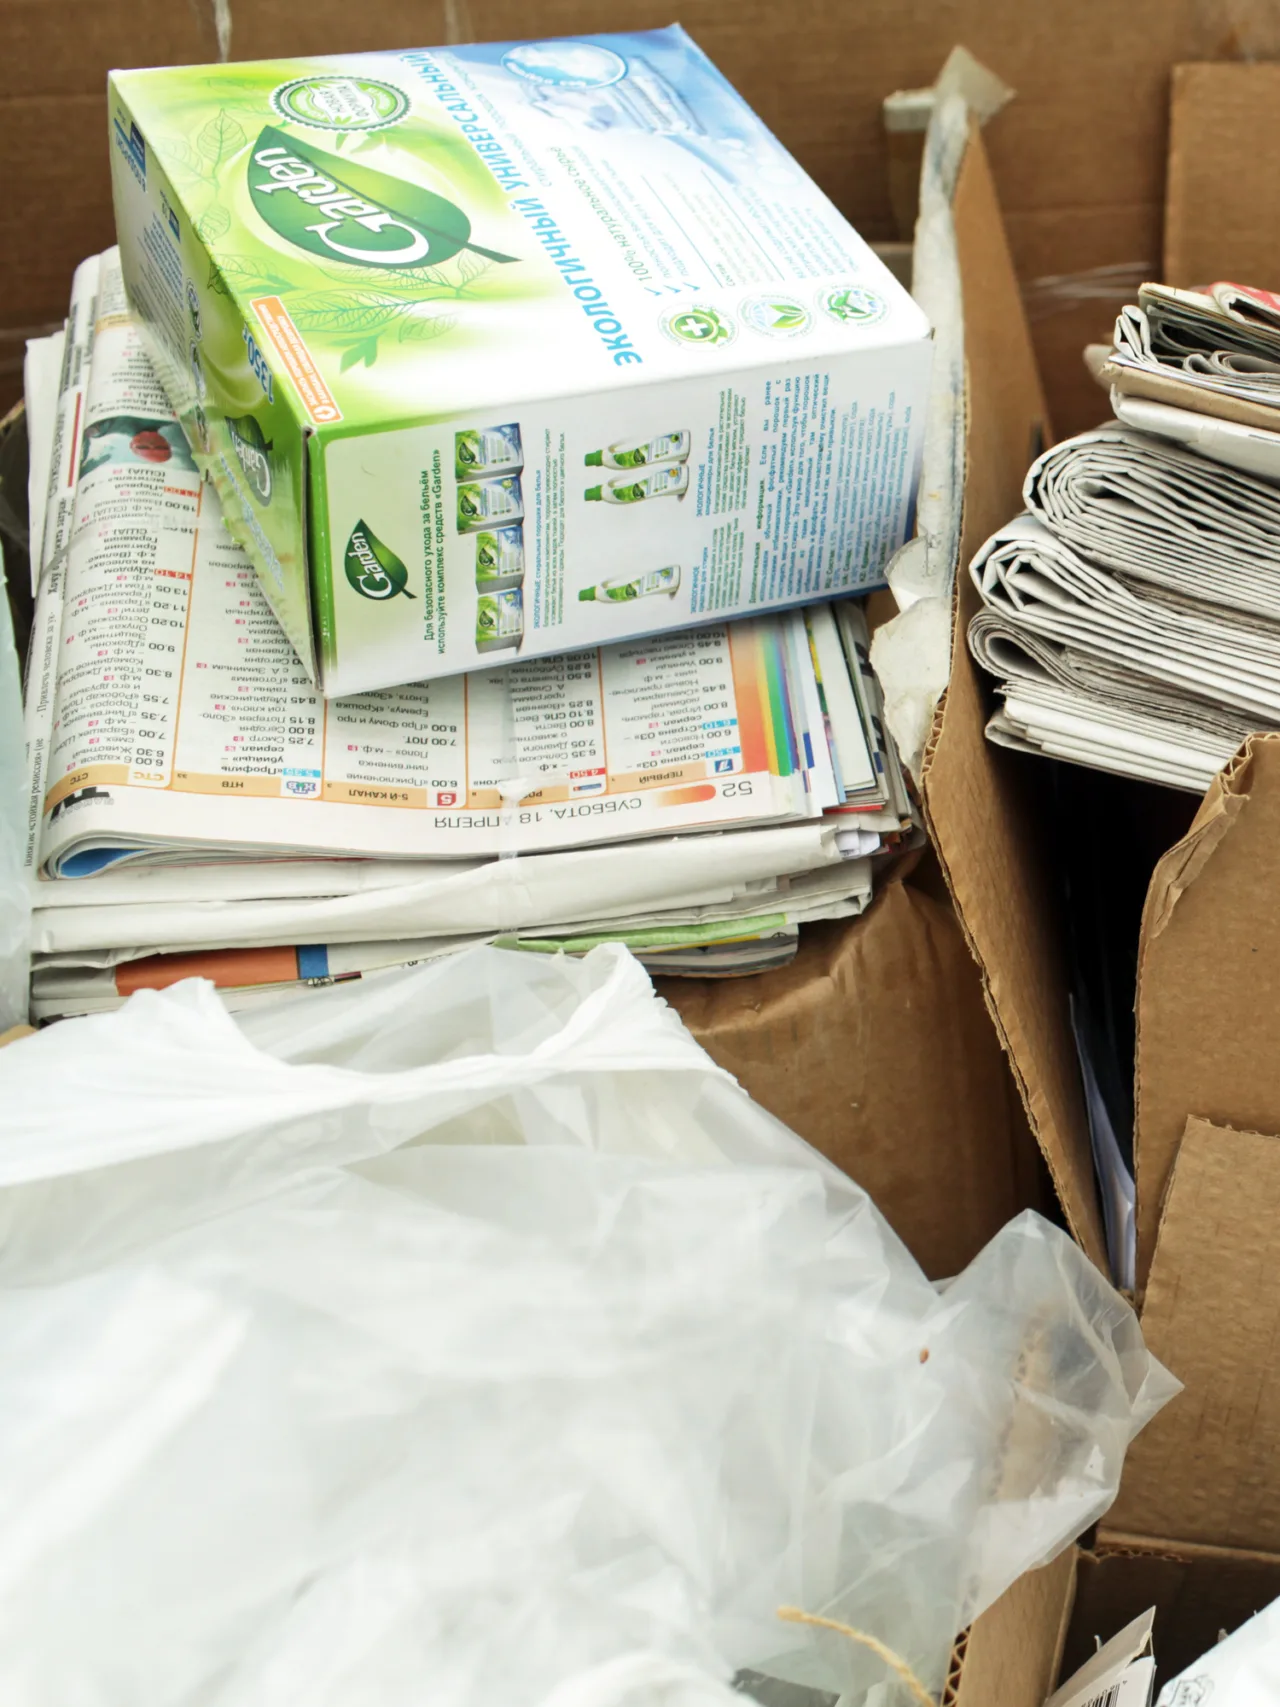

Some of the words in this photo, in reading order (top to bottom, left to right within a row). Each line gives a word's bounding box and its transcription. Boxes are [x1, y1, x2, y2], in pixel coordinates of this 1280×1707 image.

[318, 89, 347, 113] НОВАЯ
[333, 83, 372, 118] ФОРМУЛА
[396, 50, 532, 192] УНИВЕРСАЛЬНЫЙ
[546, 145, 584, 177] сырьё
[253, 146, 430, 265] Garden
[570, 177, 635, 247] натуральное
[617, 249, 656, 282] 100%
[504, 196, 652, 366] ЭКОЛОГИЧНЫЙ
[763, 380, 772, 405] ранее
[790, 376, 801, 413] функцию
[801, 375, 810, 410] порошок
[810, 373, 820, 419] оптический
[771, 395, 781, 433] порошок
[781, 396, 790, 428] первый
[762, 418, 769, 431] вы
[798, 412, 807, 437] чтобы
[759, 444, 767, 465] Если
[798, 439, 806, 458] того,
[430, 448, 442, 499] «Garden»
[766, 443, 777, 492] фосфатный
[796, 460, 804, 475] для
[418, 469, 430, 511] бельём
[695, 462, 705, 517] ЭКОЛОГИЧНЫЕ
[422, 512, 430, 524] за
[434, 501, 444, 544] средств
[422, 526, 433, 557] ухода
[104, 566, 154, 574] «Дурдом
[347, 531, 392, 599] Garden
[434, 545, 445, 593] комплекс
[48, 572, 62, 594] Хочу
[156, 585, 187, 595] 13.05
[422, 558, 434, 621] безопасного
[153, 601, 186, 612] 11.20
[152, 618, 184, 628] 10.20
[435, 595, 447, 654] используйте
[84, 632, 146, 643] Защитники
[424, 622, 435, 641] Для
[41, 635, 54, 671] человека
[149, 643, 175, 652] 9.00
[242, 657, 289, 665] Сегодня.
[114, 666, 142, 674] «Том
[146, 668, 172, 678] 8.30
[37, 673, 52, 712] Привлечь
[86, 692, 139, 702] «Робокар
[210, 693, 287, 703] Медицинские
[143, 694, 169, 704] 7.55
[335, 702, 384, 713] «Крошка
[569, 709, 593, 718] 8.10
[63, 710, 137, 728] «Пингвиненок
[141, 712, 167, 721] 7.35
[239, 715, 285, 723] Лотерея
[337, 715, 356, 724] про
[370, 717, 399, 729] Фому
[402, 720, 428, 730] «Про
[432, 724, 457, 733] 8.00
[570, 720, 594, 728] 8.00
[78, 728, 134, 737] «Барашек
[139, 730, 165, 739] 7.00
[634, 732, 655, 740] 03»
[658, 724, 702, 737] «Страна
[707, 729, 731, 738] 6.00
[34, 739, 45, 751] (не
[289, 737, 314, 745] 7.25
[403, 736, 428, 745] ЛОТ.
[432, 738, 456, 746] 7.00
[523, 741, 567, 752] Диалоги
[571, 739, 595, 747] 7.05
[72, 745, 132, 758] Животный
[137, 748, 164, 756] 6.30
[360, 745, 383, 754] м.ф.
[396, 748, 428, 759] Поло»
[572, 749, 596, 757] 6.35
[136, 757, 163, 766] 6.00
[232, 756, 284, 764] убийцы»
[636, 760, 657, 768] 03»
[660, 752, 705, 765] «Страна
[221, 766, 282, 775] «Профиль
[358, 759, 428, 771] пингвиненка
[30, 752, 44, 794] ремиссия»
[70, 772, 88, 784] СТС
[133, 772, 164, 781] СТС
[639, 770, 682, 783] ПЕРВЫЙ
[346, 773, 428, 787] «Приключение
[432, 779, 457, 788] 6.00
[286, 781, 316, 794] НТВ
[722, 780, 752, 797] 52
[348, 789, 387, 799] КАНАЛ
[389, 791, 408, 801] 5-Й
[28, 796, 41, 831] «стойкая
[550, 797, 641, 819] СУББОТА,
[519, 812, 542, 823] 18
